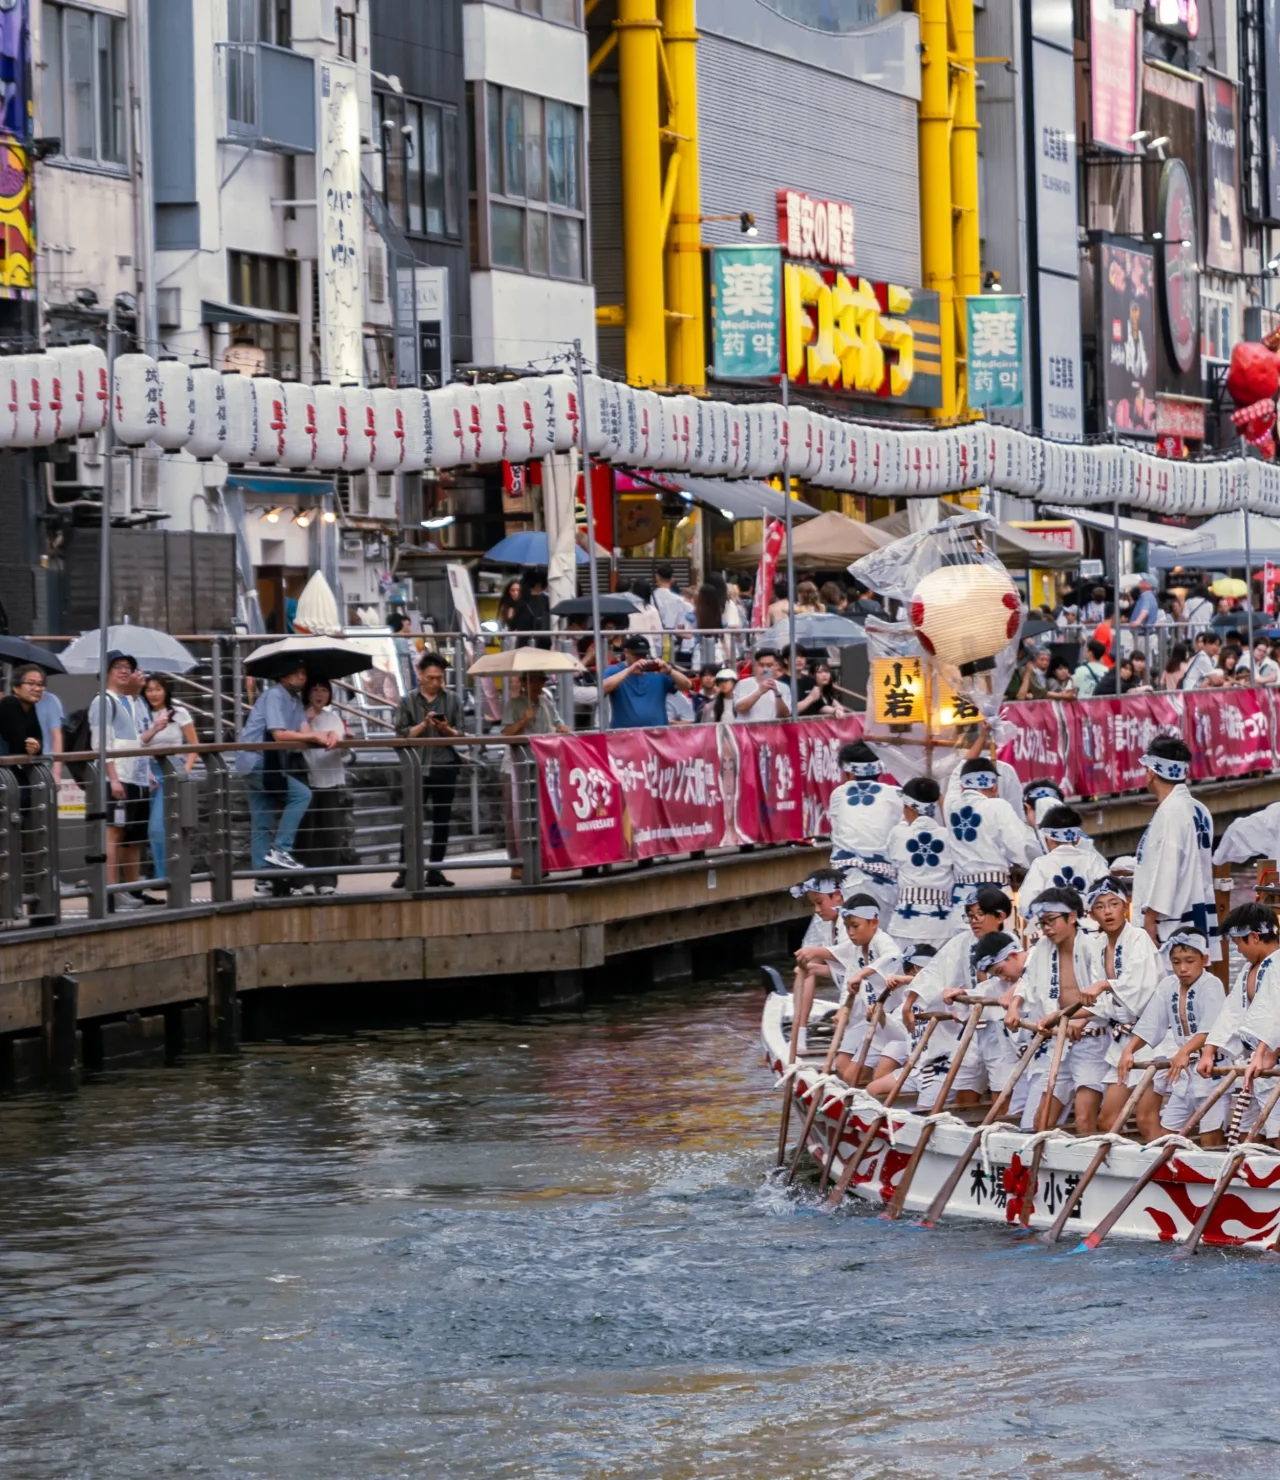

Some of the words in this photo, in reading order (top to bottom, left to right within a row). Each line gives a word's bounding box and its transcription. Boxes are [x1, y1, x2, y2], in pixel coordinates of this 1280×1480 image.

[721, 263, 775, 316] 薬
[720, 319, 775, 330] Medicine
[971, 311, 1018, 356] 薬
[971, 359, 1019, 369] Medicine
[884, 661, 915, 718] 小若
[1154, 761, 1163, 774] 木
[576, 818, 615, 831] ANNIVERSARY
[970, 1161, 1008, 1210] 木場
[1043, 1173, 1084, 1219] 小若
